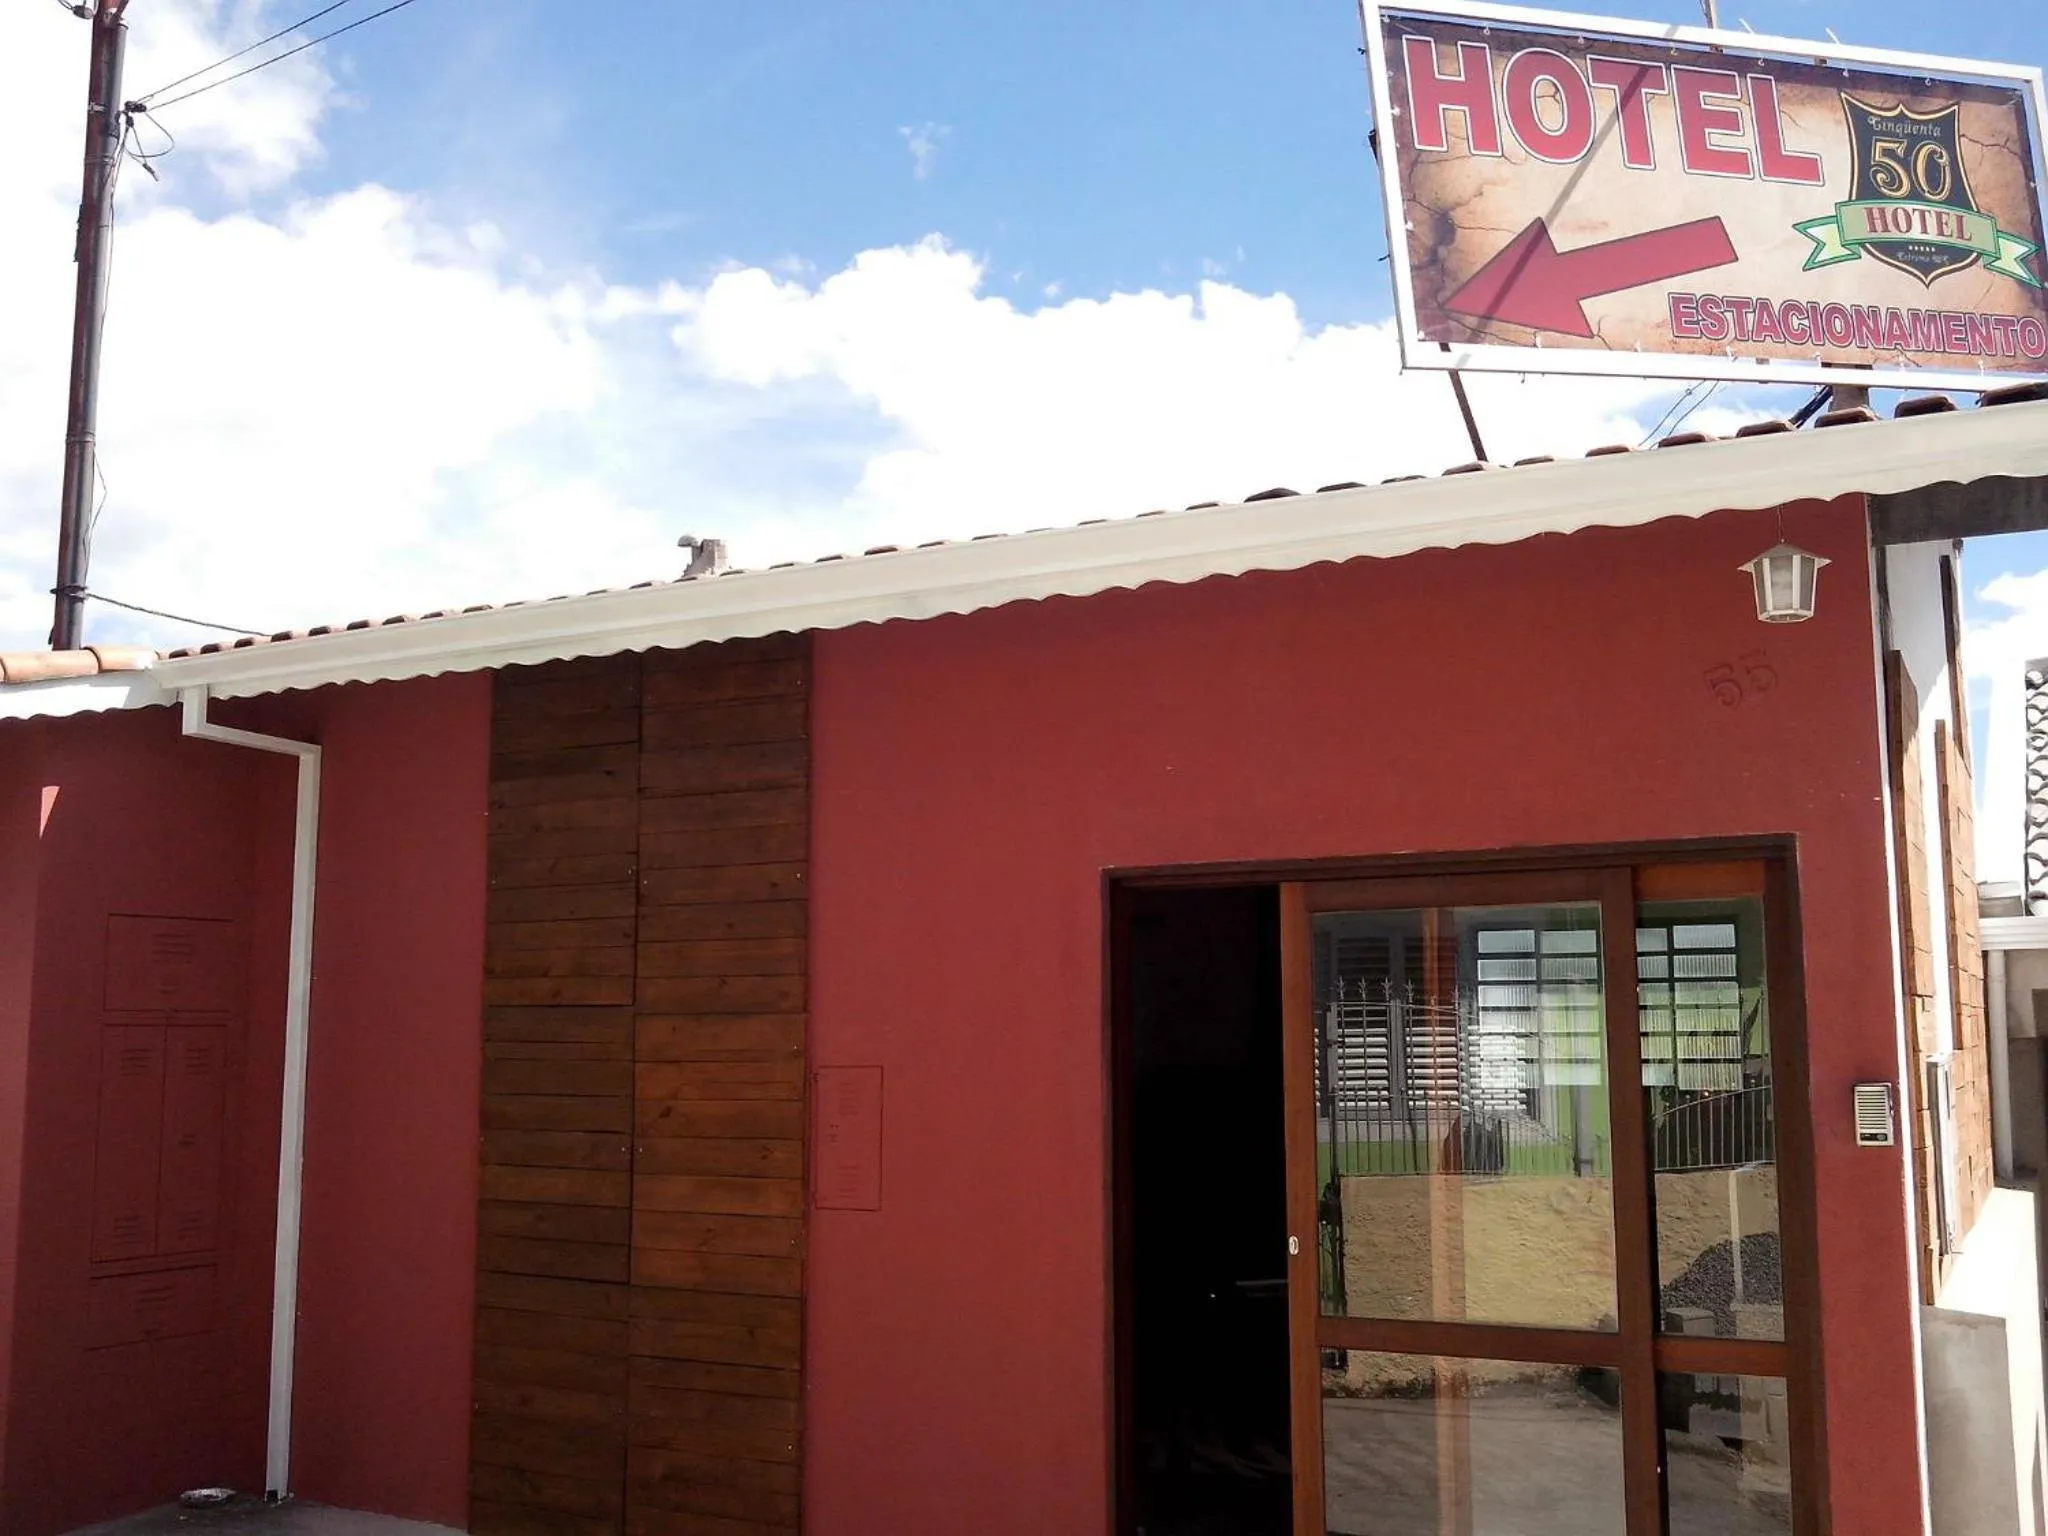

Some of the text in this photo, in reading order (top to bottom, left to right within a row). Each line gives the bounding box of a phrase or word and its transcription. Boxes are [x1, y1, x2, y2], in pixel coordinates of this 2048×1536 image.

[1402, 34, 1825, 186] HOTEL
[1870, 137, 1952, 201] 50
[1864, 206, 1972, 241] HOTEL
[1667, 292, 2047, 358] ESTACIONAMENTO
[1703, 648, 1778, 711] 55
